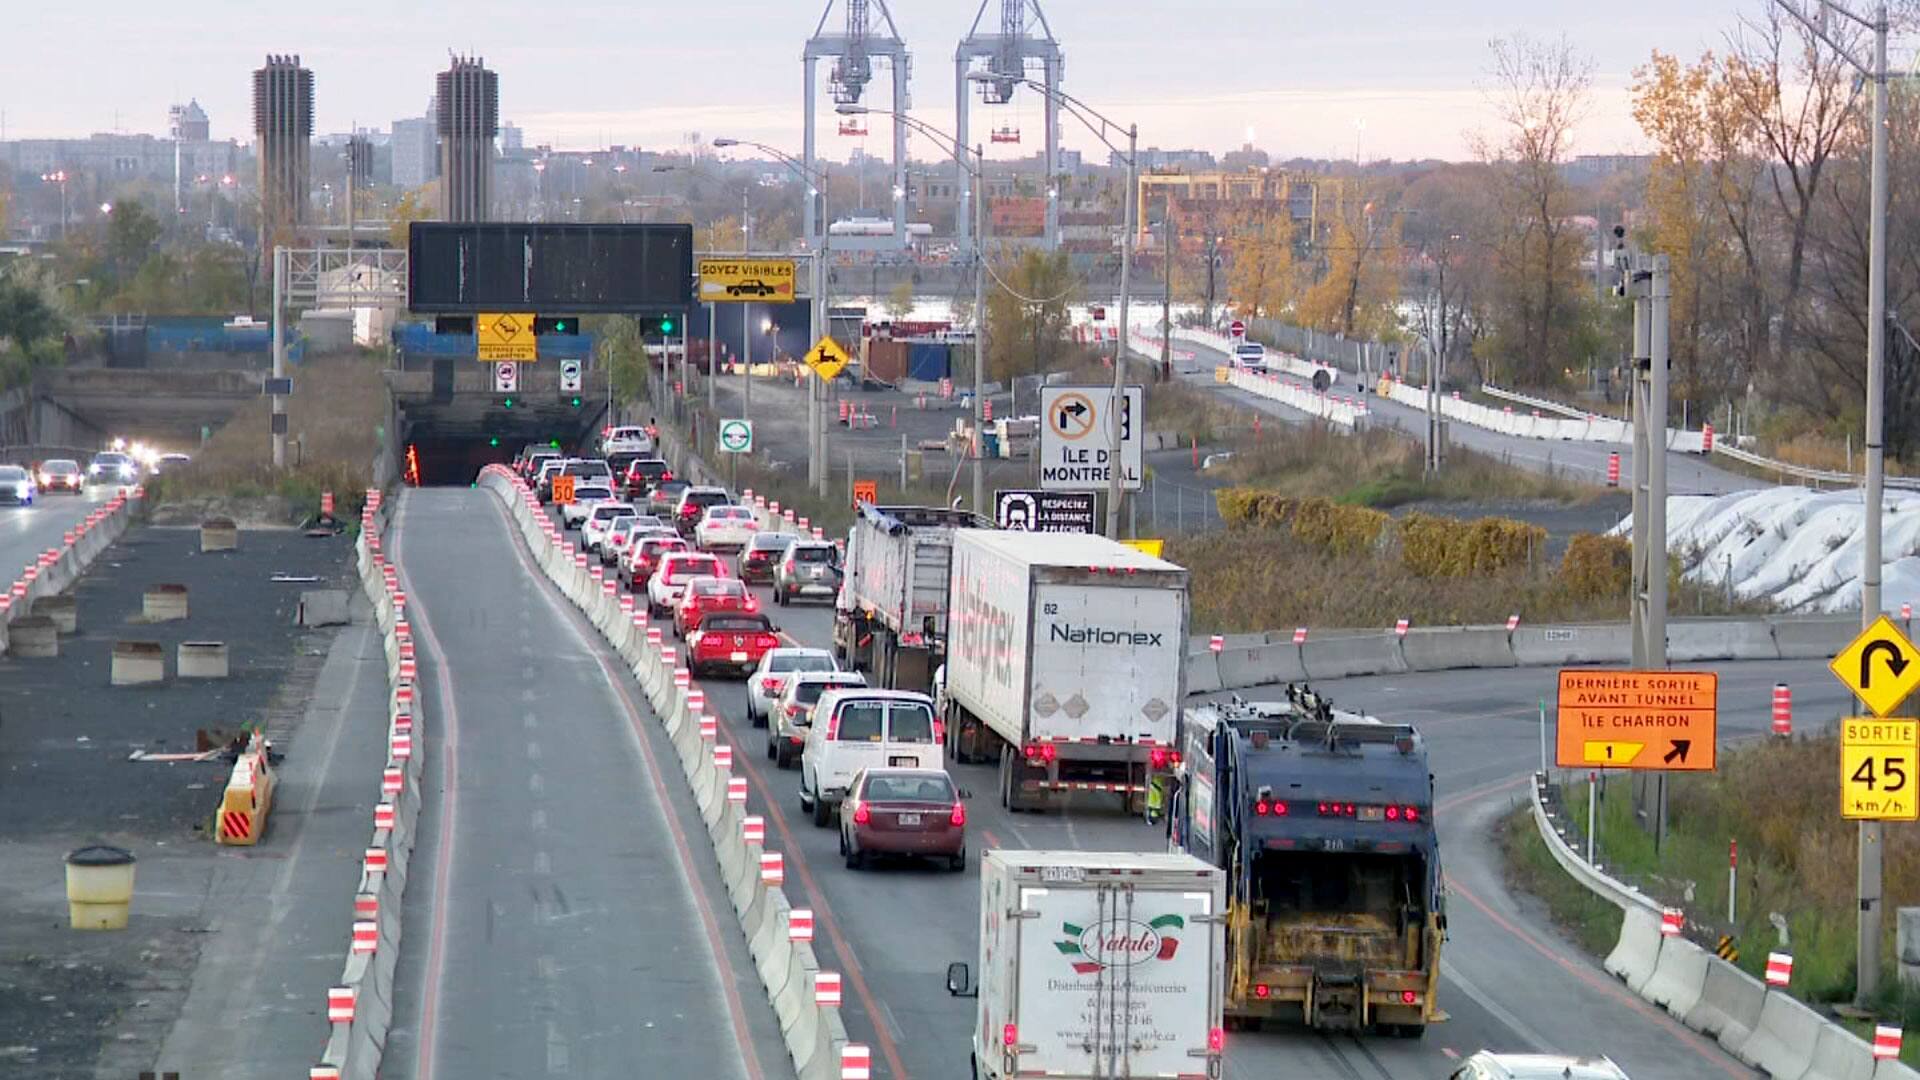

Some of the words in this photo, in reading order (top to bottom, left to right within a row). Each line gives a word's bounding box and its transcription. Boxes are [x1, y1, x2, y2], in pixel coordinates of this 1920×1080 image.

[702, 265, 738, 274] SOYEZ
[742, 265, 792, 276] VISIBLES
[1062, 446, 1089, 463] ÎLE
[1097, 449, 1110, 463] D
[554, 485, 573, 501] 50
[1038, 511, 1050, 521] LA
[1051, 511, 1091, 523] DISTANCE
[1050, 623, 1163, 647] Nationex
[1566, 677, 1640, 690] DERNIÈRE
[1648, 679, 1701, 691] SORTIE
[1577, 693, 1628, 704] AVANT
[1636, 693, 1695, 705] TUNNEL
[1581, 712, 1604, 728] ÎLE
[1612, 715, 1690, 728] CHARRON
[1848, 725, 1912, 741] SORTIE
[1605, 745, 1613, 759] 1
[1851, 756, 1906, 792] 45
[1855, 798, 1903, 813] km/h
[1084, 930, 1155, 952] Natale
